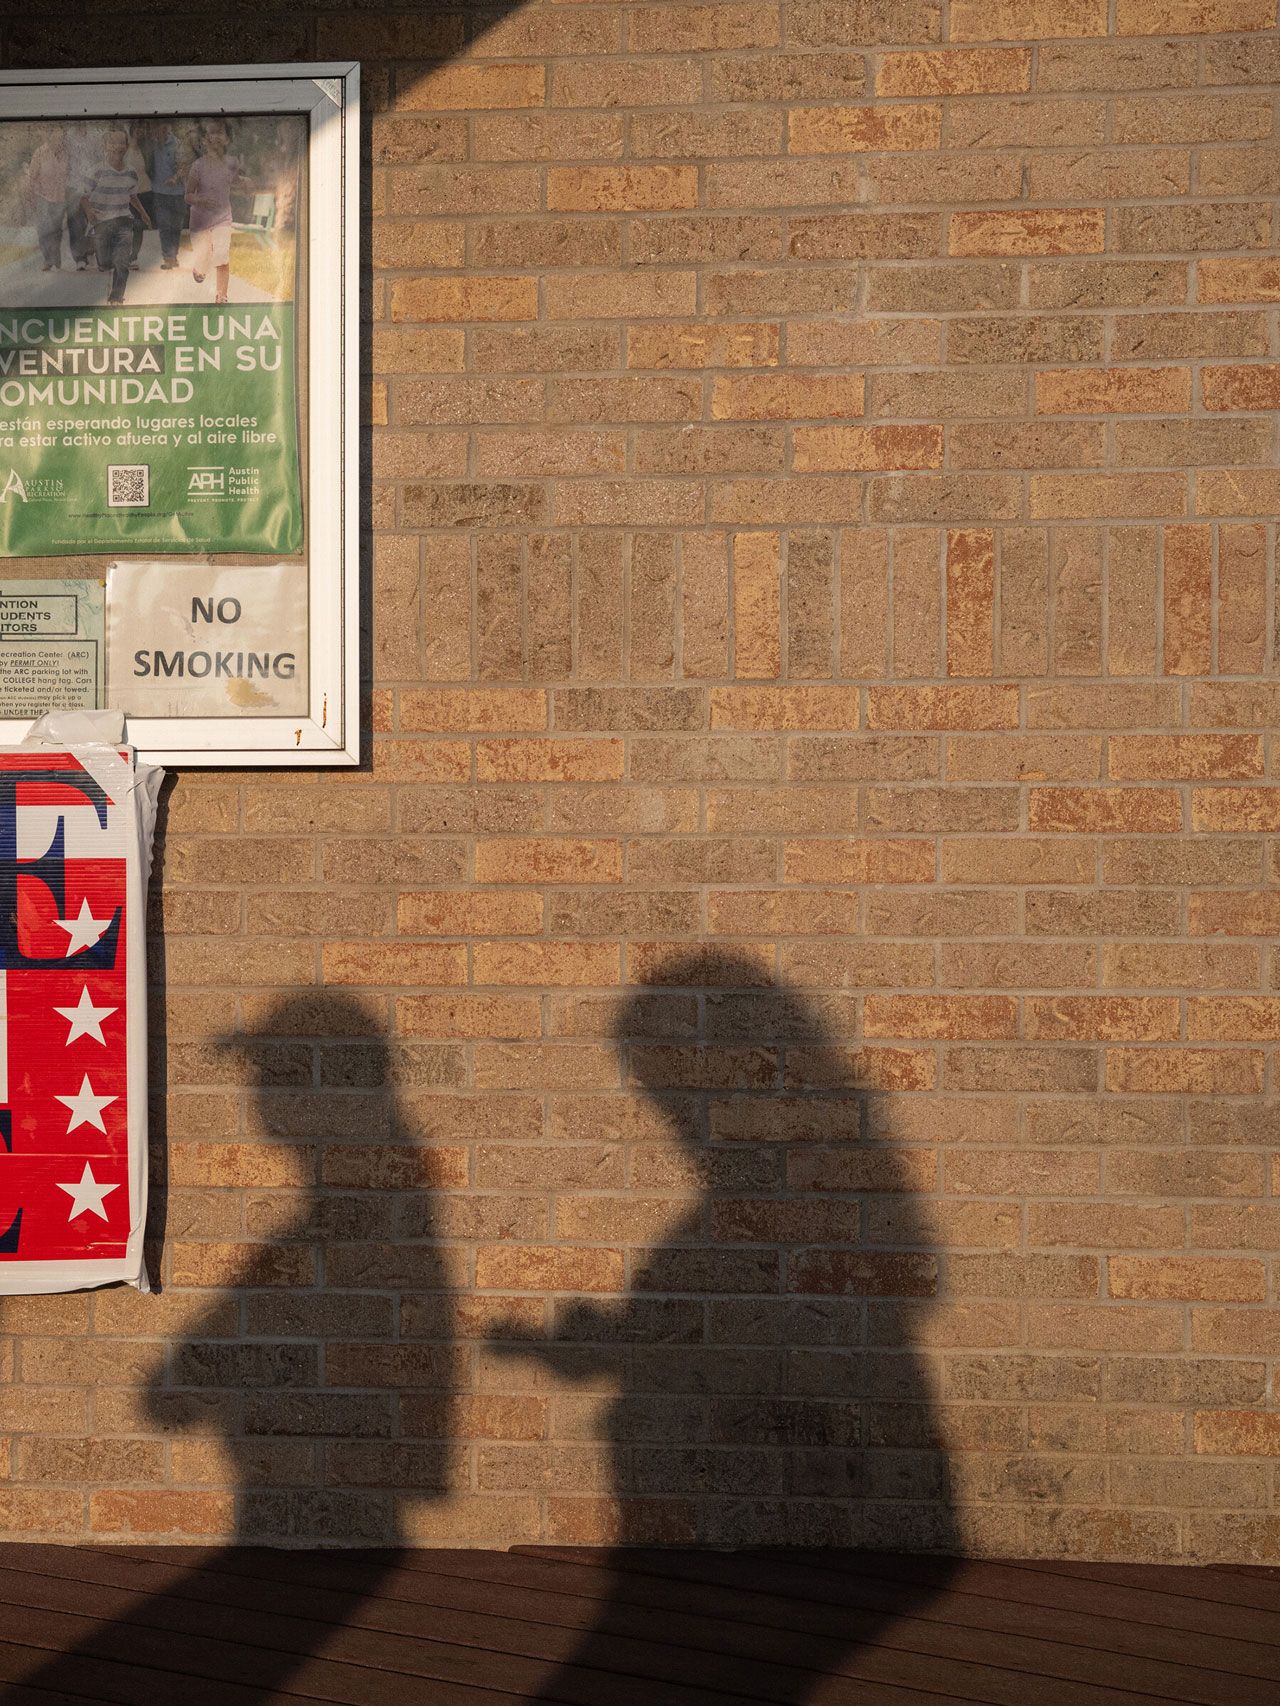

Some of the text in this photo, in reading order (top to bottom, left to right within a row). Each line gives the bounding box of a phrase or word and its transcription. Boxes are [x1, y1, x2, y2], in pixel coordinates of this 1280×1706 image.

[202, 315, 280, 342] UNA
[175, 347, 221, 373] EN
[236, 345, 282, 373] SU
[47, 416, 132, 434] esperando
[136, 416, 195, 432] lugares
[200, 414, 258, 429] locales
[19, 435, 58, 448] estar
[62, 433, 112, 447] activo
[116, 432, 167, 446] afuera
[173, 436, 182, 448] y
[186, 431, 202, 445] al
[207, 431, 237, 445] aire
[242, 430, 277, 444] libre
[228, 467, 259, 475] Austin
[24, 479, 63, 487] AUSTIN
[188, 472, 225, 490] APH
[228, 476, 259, 485] Public
[228, 486, 260, 495] Health
[191, 597, 242, 624] NO
[67, 651, 90, 660] (ARC)
[133, 650, 296, 679] SMOKING
[31, 668, 60, 676] parking
[37, 677, 57, 686] hang
